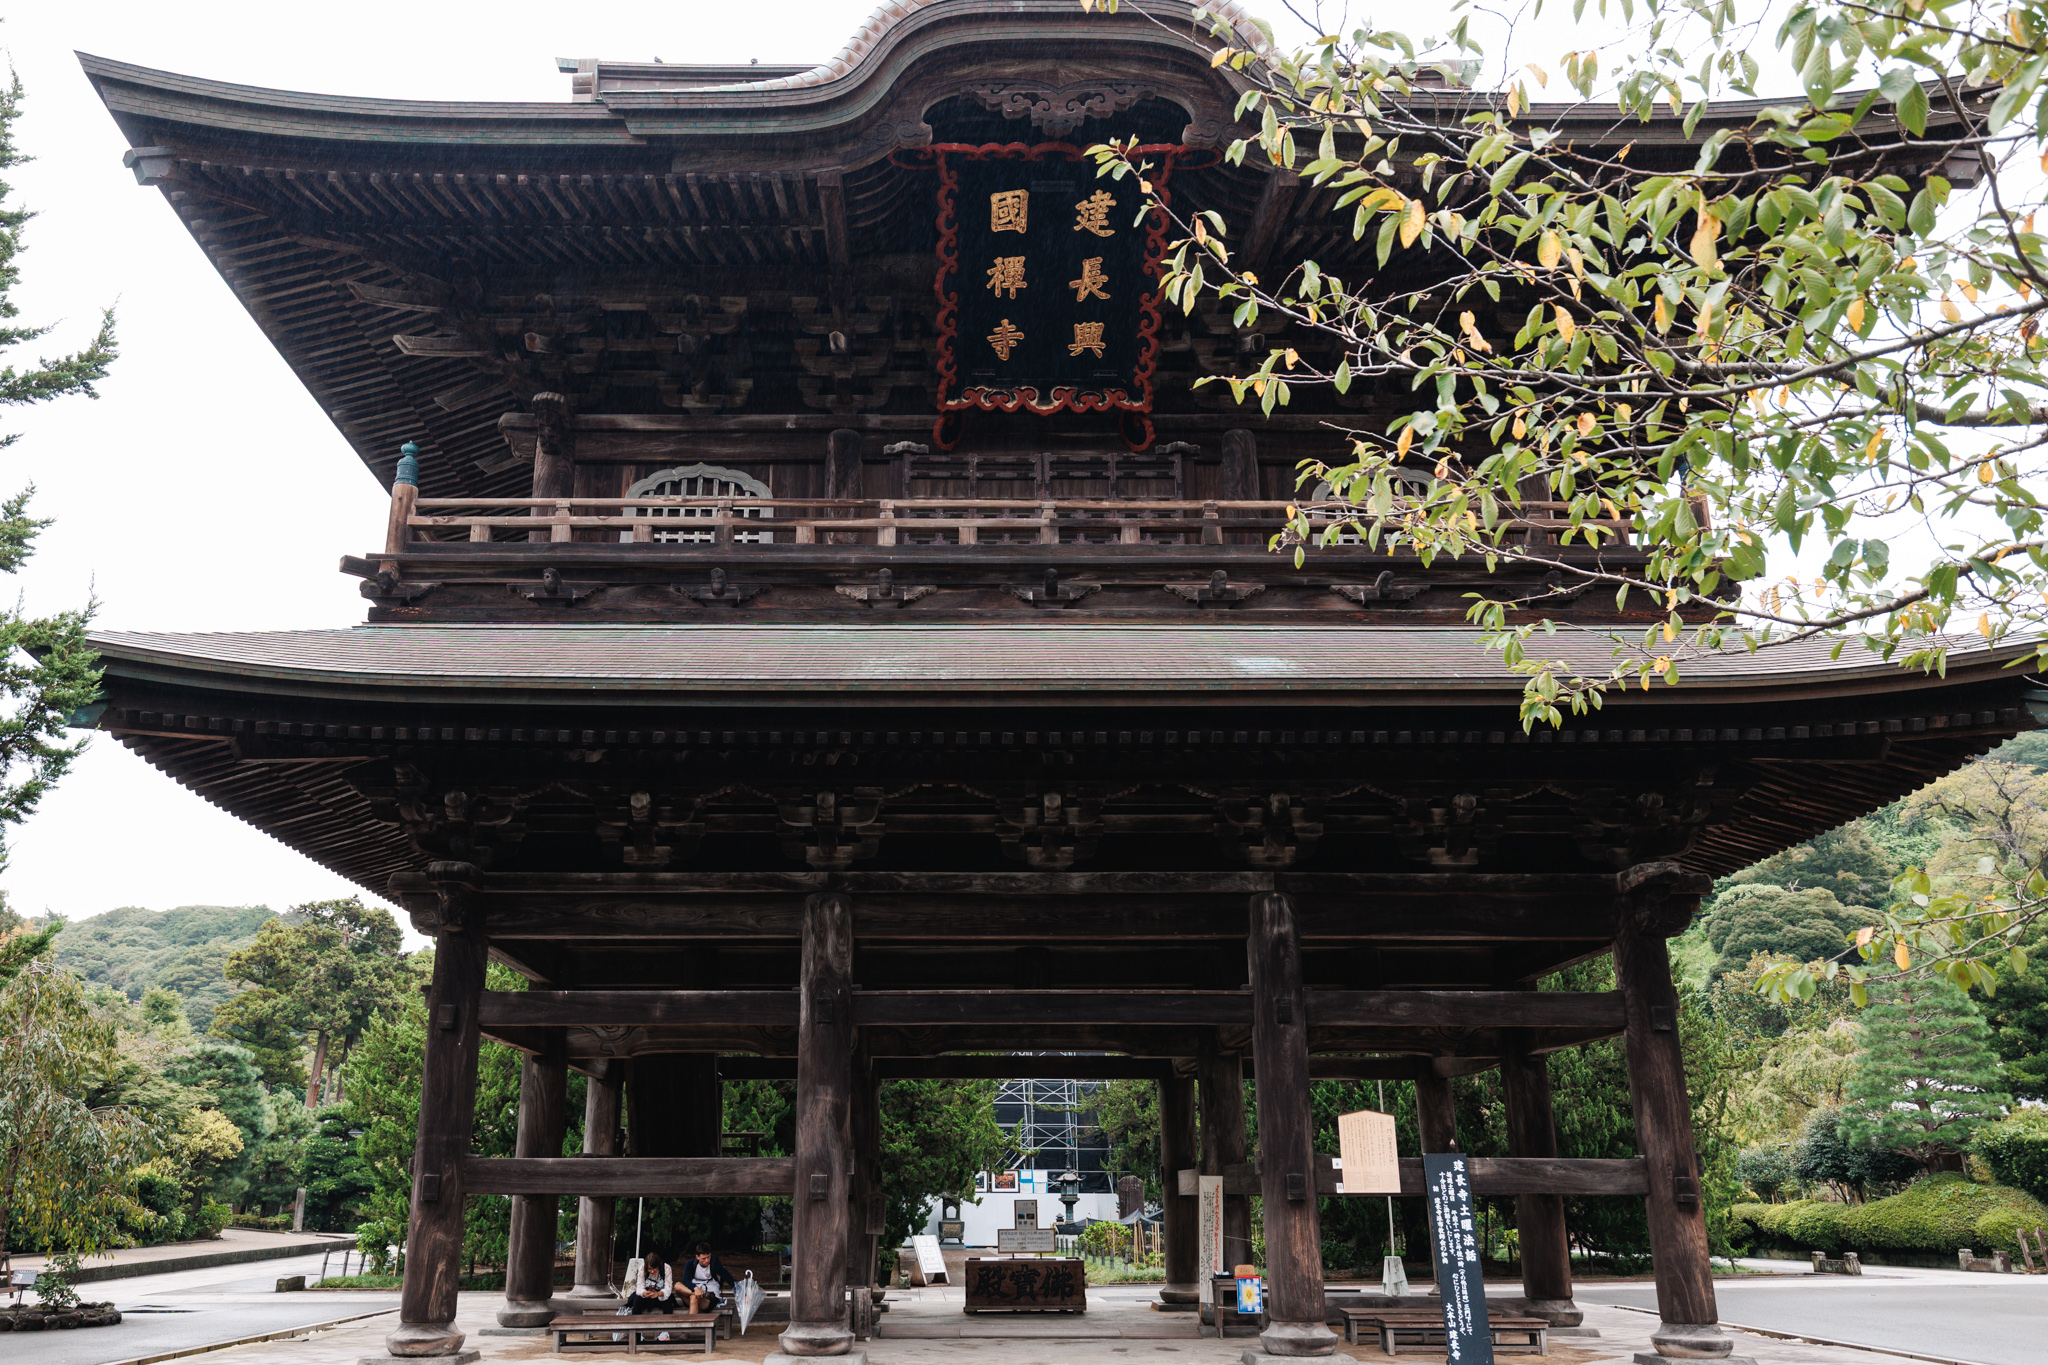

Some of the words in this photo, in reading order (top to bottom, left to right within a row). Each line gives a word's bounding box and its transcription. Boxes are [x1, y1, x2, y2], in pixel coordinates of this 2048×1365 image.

[1068, 189, 1117, 358] 建長興
[1452, 1159, 1477, 1261] 建長寺土曜法話
